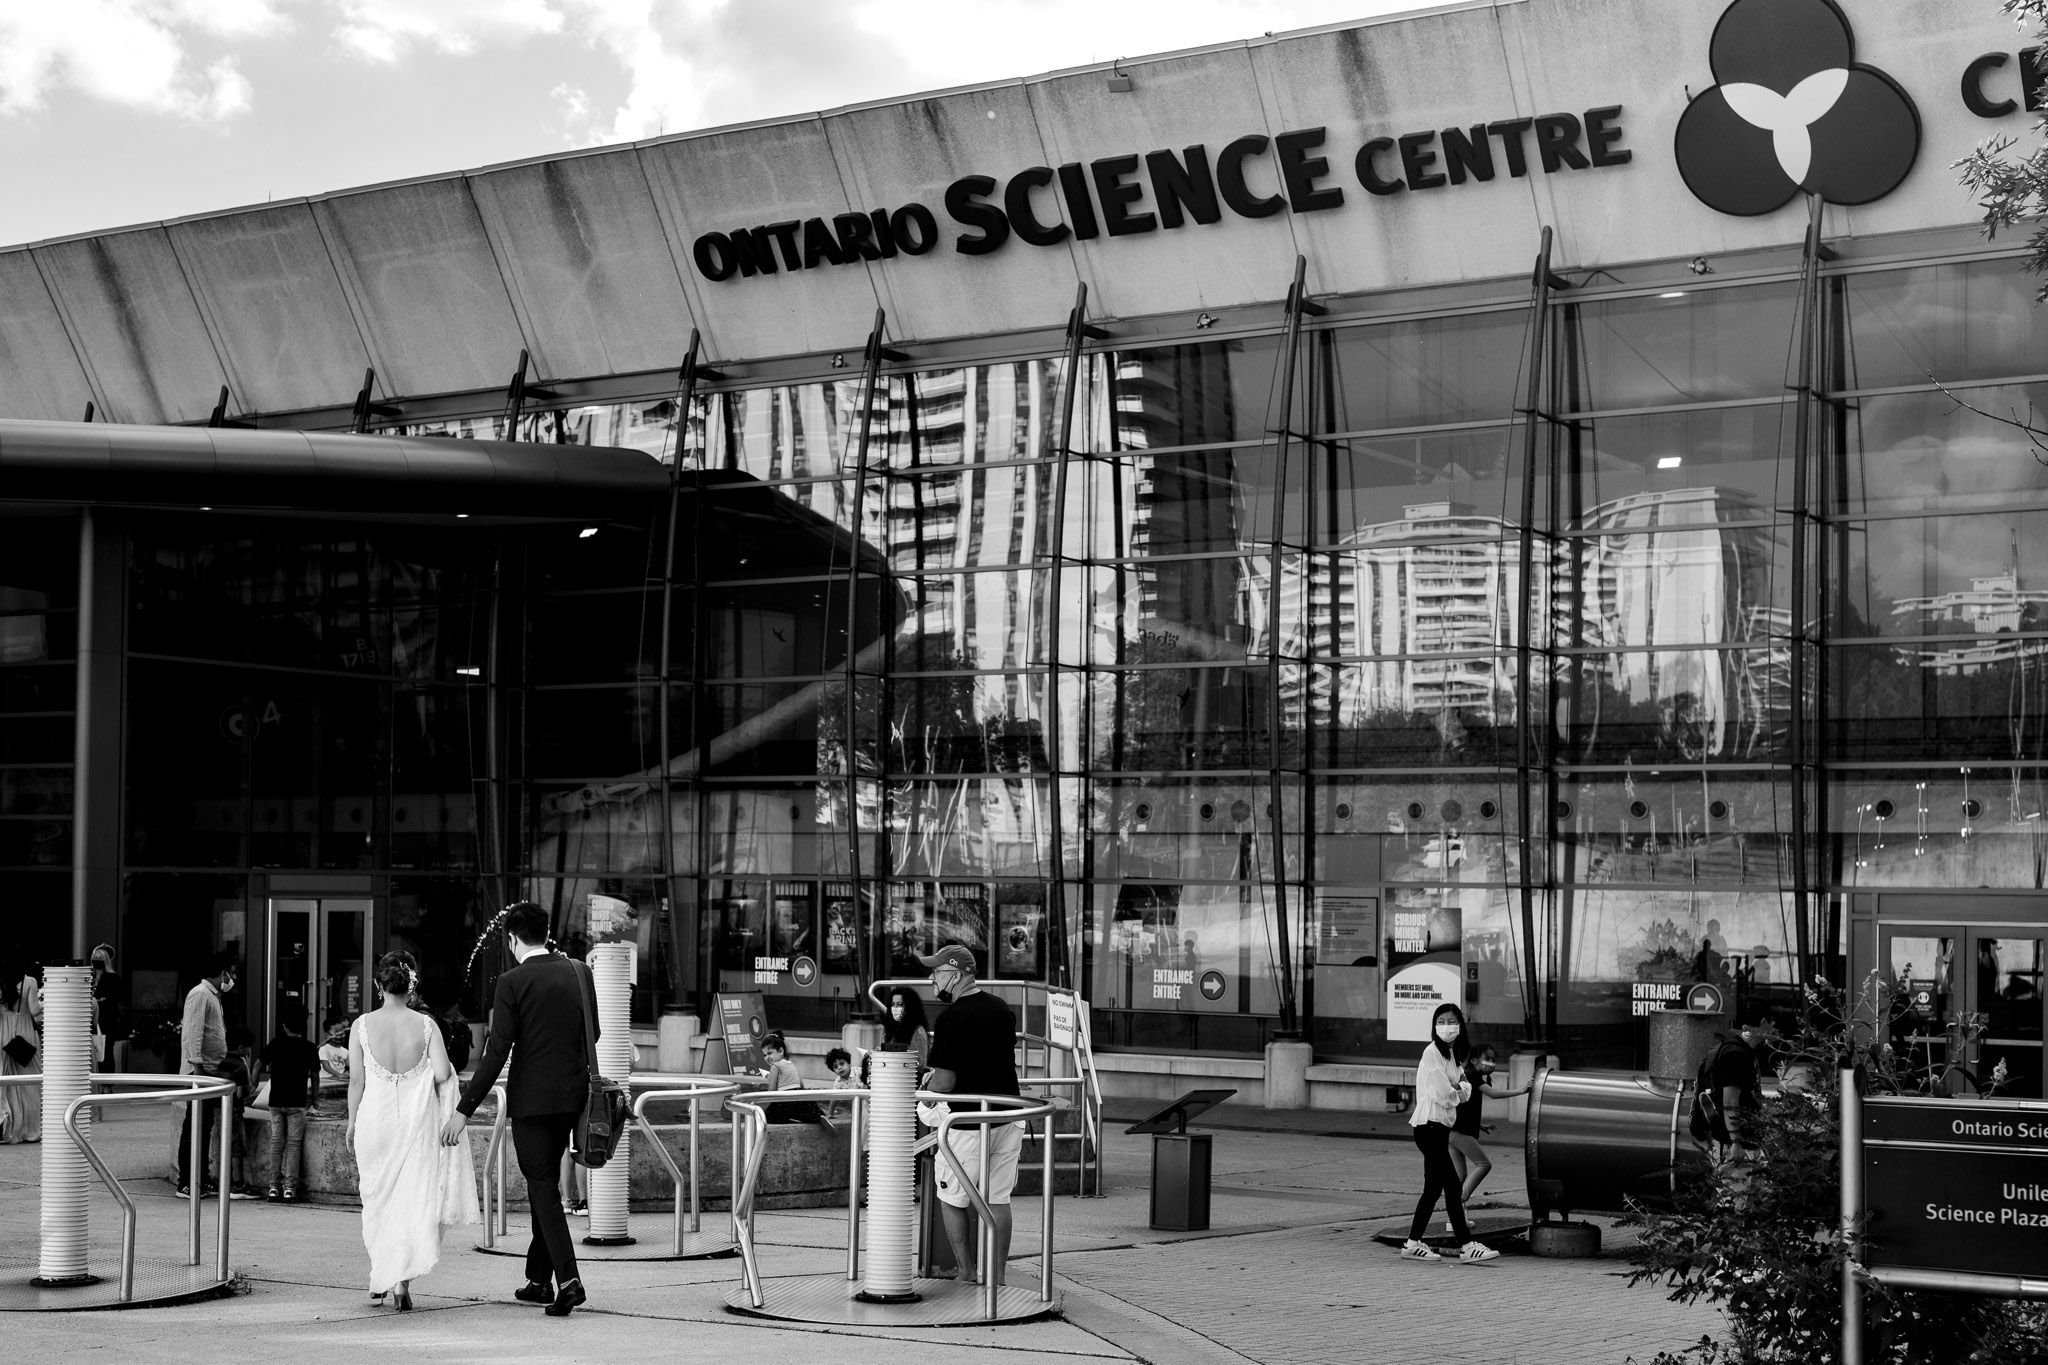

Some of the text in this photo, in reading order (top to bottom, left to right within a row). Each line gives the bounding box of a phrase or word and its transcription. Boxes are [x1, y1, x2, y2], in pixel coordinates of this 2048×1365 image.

[693, 104, 1632, 282] ONTARIO SCIENCE CENTRE
[1395, 913, 1426, 927] CURIOUS
[1395, 926, 1420, 940] MINDS
[1395, 939, 1427, 953] WANTED.
[755, 957, 788, 970] ENTRANCE
[755, 970, 778, 984] ENTRÉE
[1153, 969, 1193, 984] ENTRANCE
[1153, 984, 1181, 999] ENTRÉE
[1632, 983, 1681, 1000] ENTRANCE
[1952, 1119, 2013, 1136] Ontario
[2003, 1183, 2048, 1201] Unile
[1926, 1203, 2048, 1227] Science Plaza
